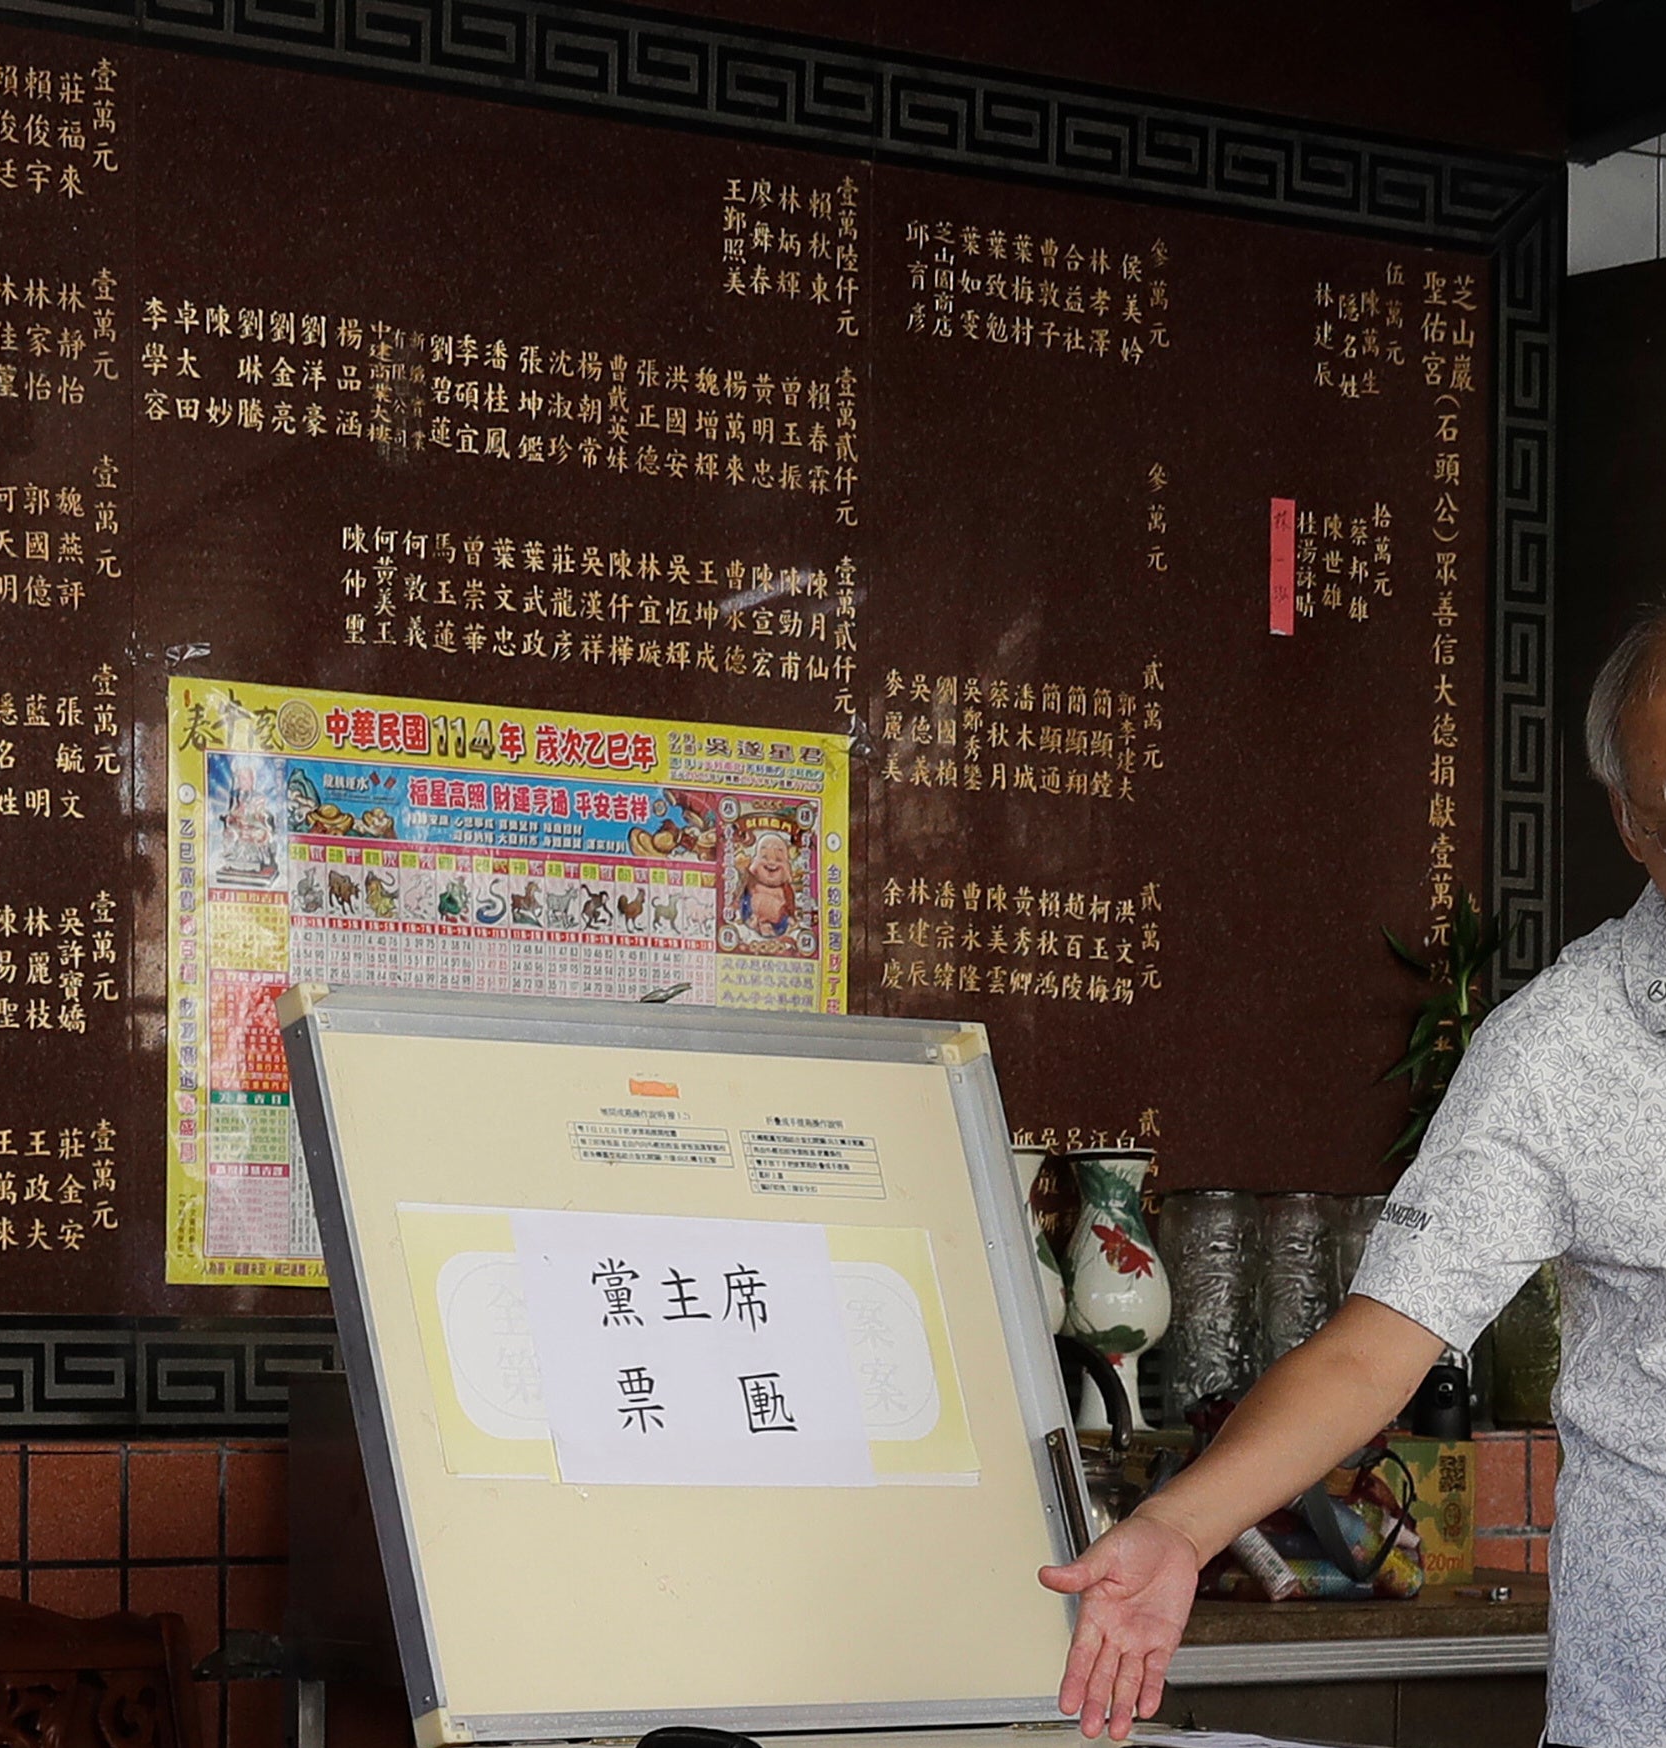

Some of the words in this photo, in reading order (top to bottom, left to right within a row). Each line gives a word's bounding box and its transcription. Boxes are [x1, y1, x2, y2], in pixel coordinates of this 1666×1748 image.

[24, 283, 53, 402] 林家怡
[174, 301, 202, 421] 卓太田
[752, 373, 776, 490] 黃明忠
[23, 483, 53, 608] 郭國億
[493, 536, 518, 658] 葉文忠
[520, 540, 549, 658] 葉武政
[54, 695, 87, 820] 張毓文
[407, 776, 489, 812] 福星高照
[492, 784, 571, 819] 財運亨通
[574, 790, 652, 824] 平安吉祥
[22, 1128, 54, 1252] 王政夫
[58, 1127, 87, 1251] 莊金安
[590, 1257, 772, 1336] 黨主席
